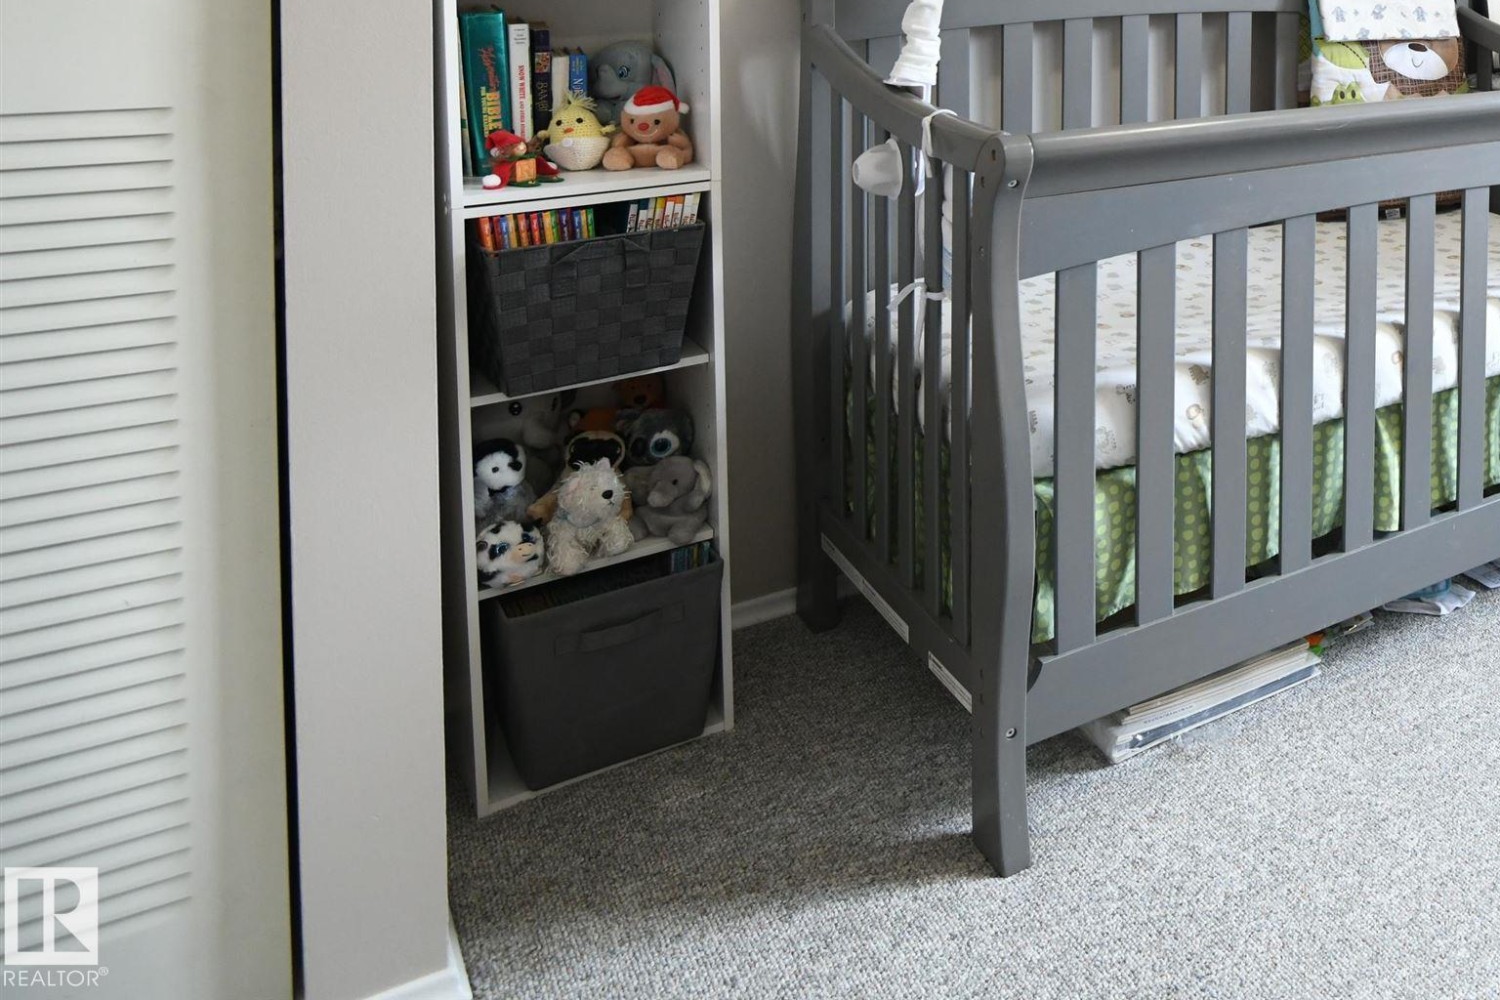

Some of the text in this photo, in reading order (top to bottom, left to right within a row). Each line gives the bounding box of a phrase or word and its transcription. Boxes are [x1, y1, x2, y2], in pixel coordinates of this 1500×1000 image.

[518, 65, 526, 81] SNOW
[518, 82, 526, 99] WHITE
[486, 91, 502, 130] BIBLE
